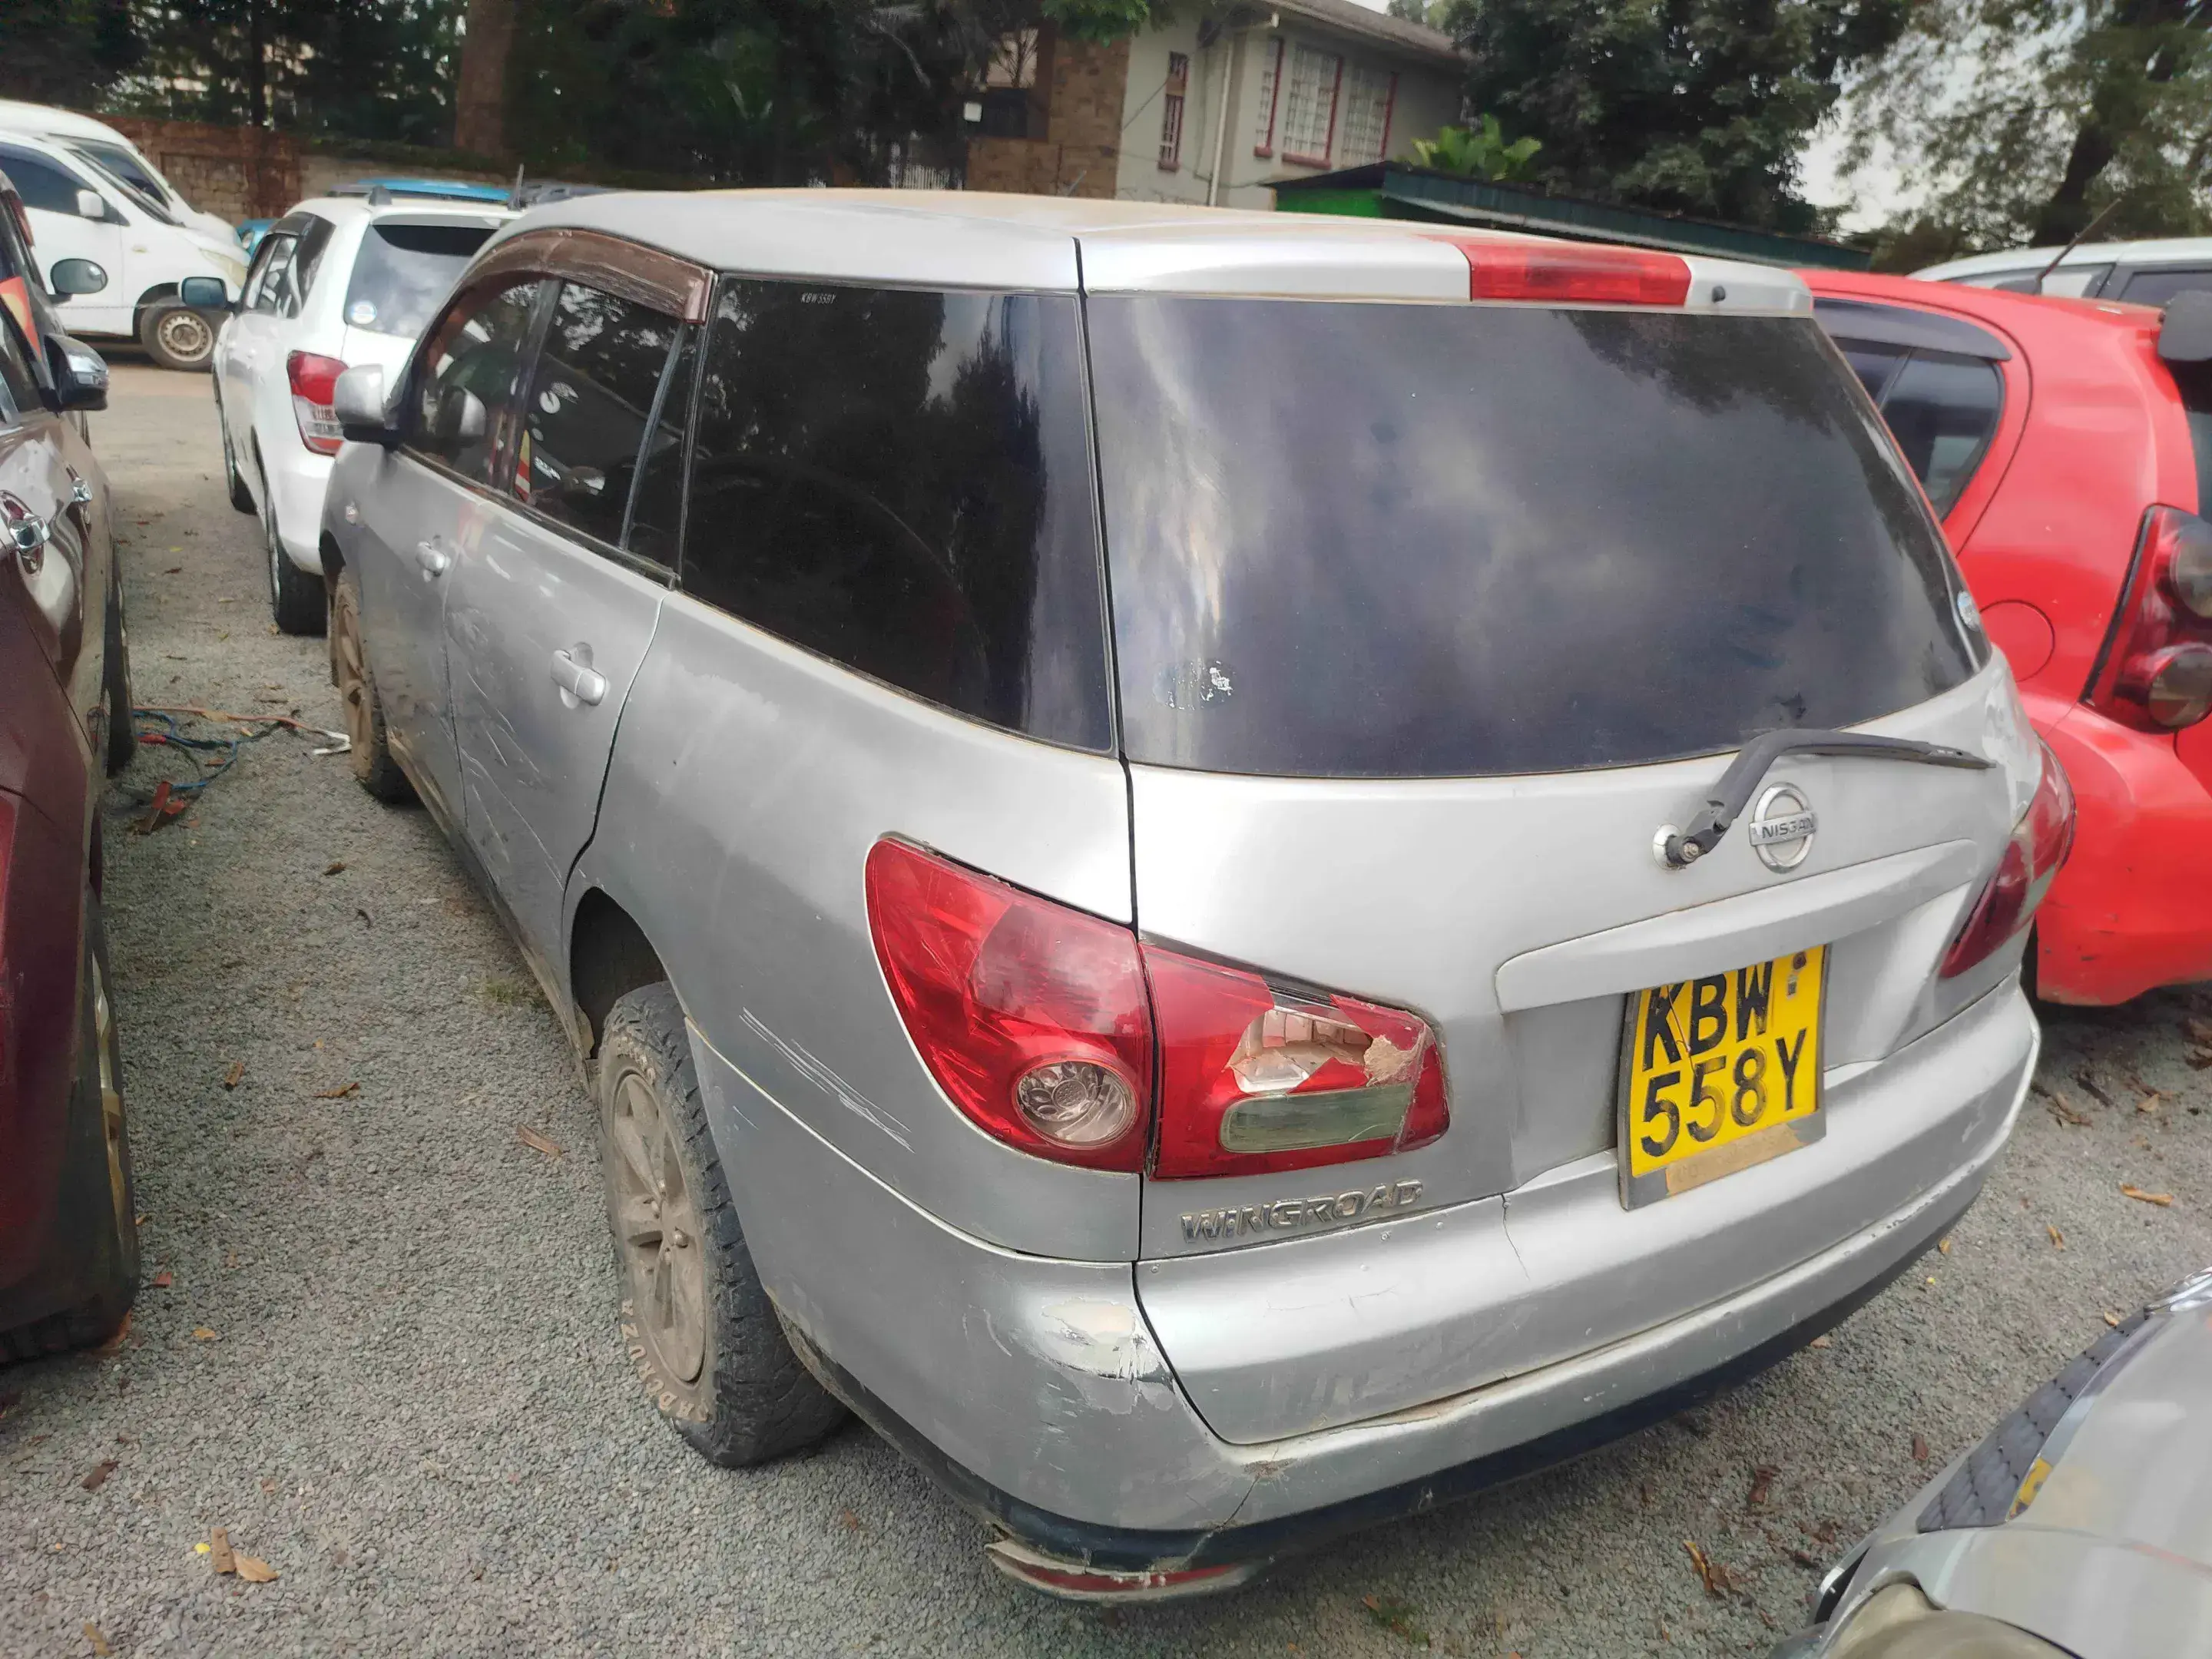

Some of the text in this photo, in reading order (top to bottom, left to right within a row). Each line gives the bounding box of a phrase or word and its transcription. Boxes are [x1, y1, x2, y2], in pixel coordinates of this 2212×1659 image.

[1761, 817, 1814, 839] NISSAN
[1642, 961, 1773, 1072] KBW
[1641, 1027, 1807, 1157] 558Y
[1181, 1179, 1423, 1243] WINGROAD
